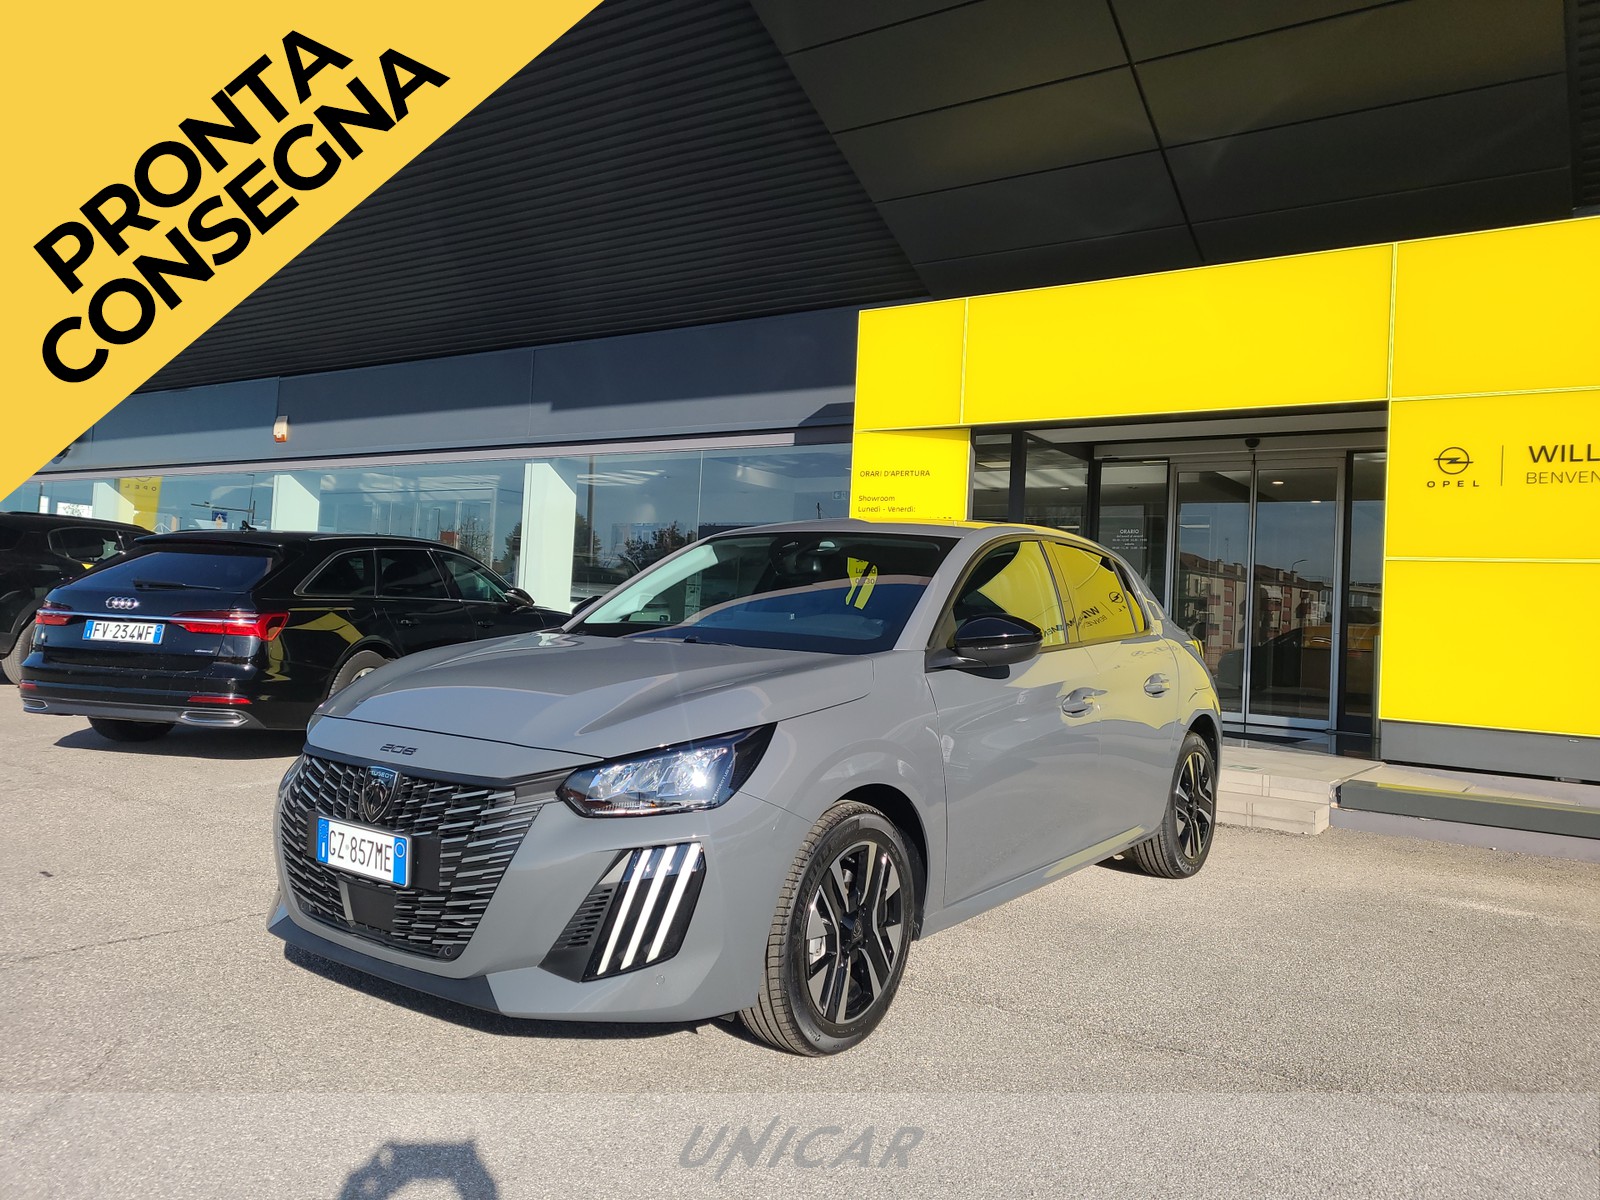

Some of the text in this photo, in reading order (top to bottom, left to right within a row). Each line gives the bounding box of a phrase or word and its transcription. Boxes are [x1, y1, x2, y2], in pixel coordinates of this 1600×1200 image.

[1529, 443, 1600, 463] WILL
[1526, 471, 1600, 485] BENVEN
[93, 623, 110, 638] FV
[112, 624, 154, 640] 234WF
[380, 744, 418, 756] 208
[329, 830, 345, 860] GZ
[350, 836, 393, 873] 857ME
